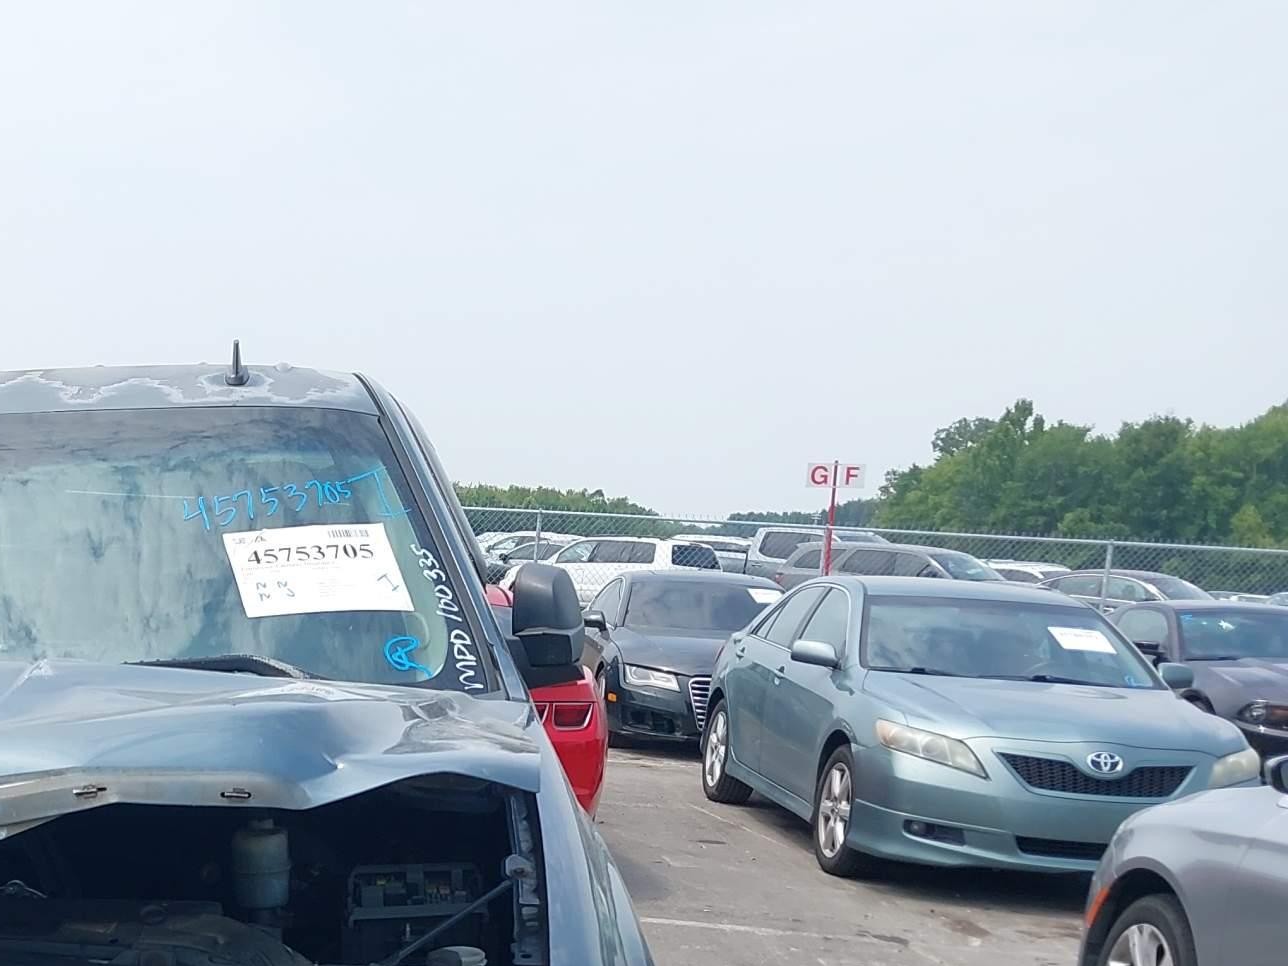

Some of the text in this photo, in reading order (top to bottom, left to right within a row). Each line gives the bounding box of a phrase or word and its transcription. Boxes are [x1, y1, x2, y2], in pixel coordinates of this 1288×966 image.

[810, 465, 829, 486] G
[844, 466, 860, 486] F
[183, 480, 352, 530] 45753705
[247, 542, 375, 565] 45753705
[449, 629, 485, 690] MPD
